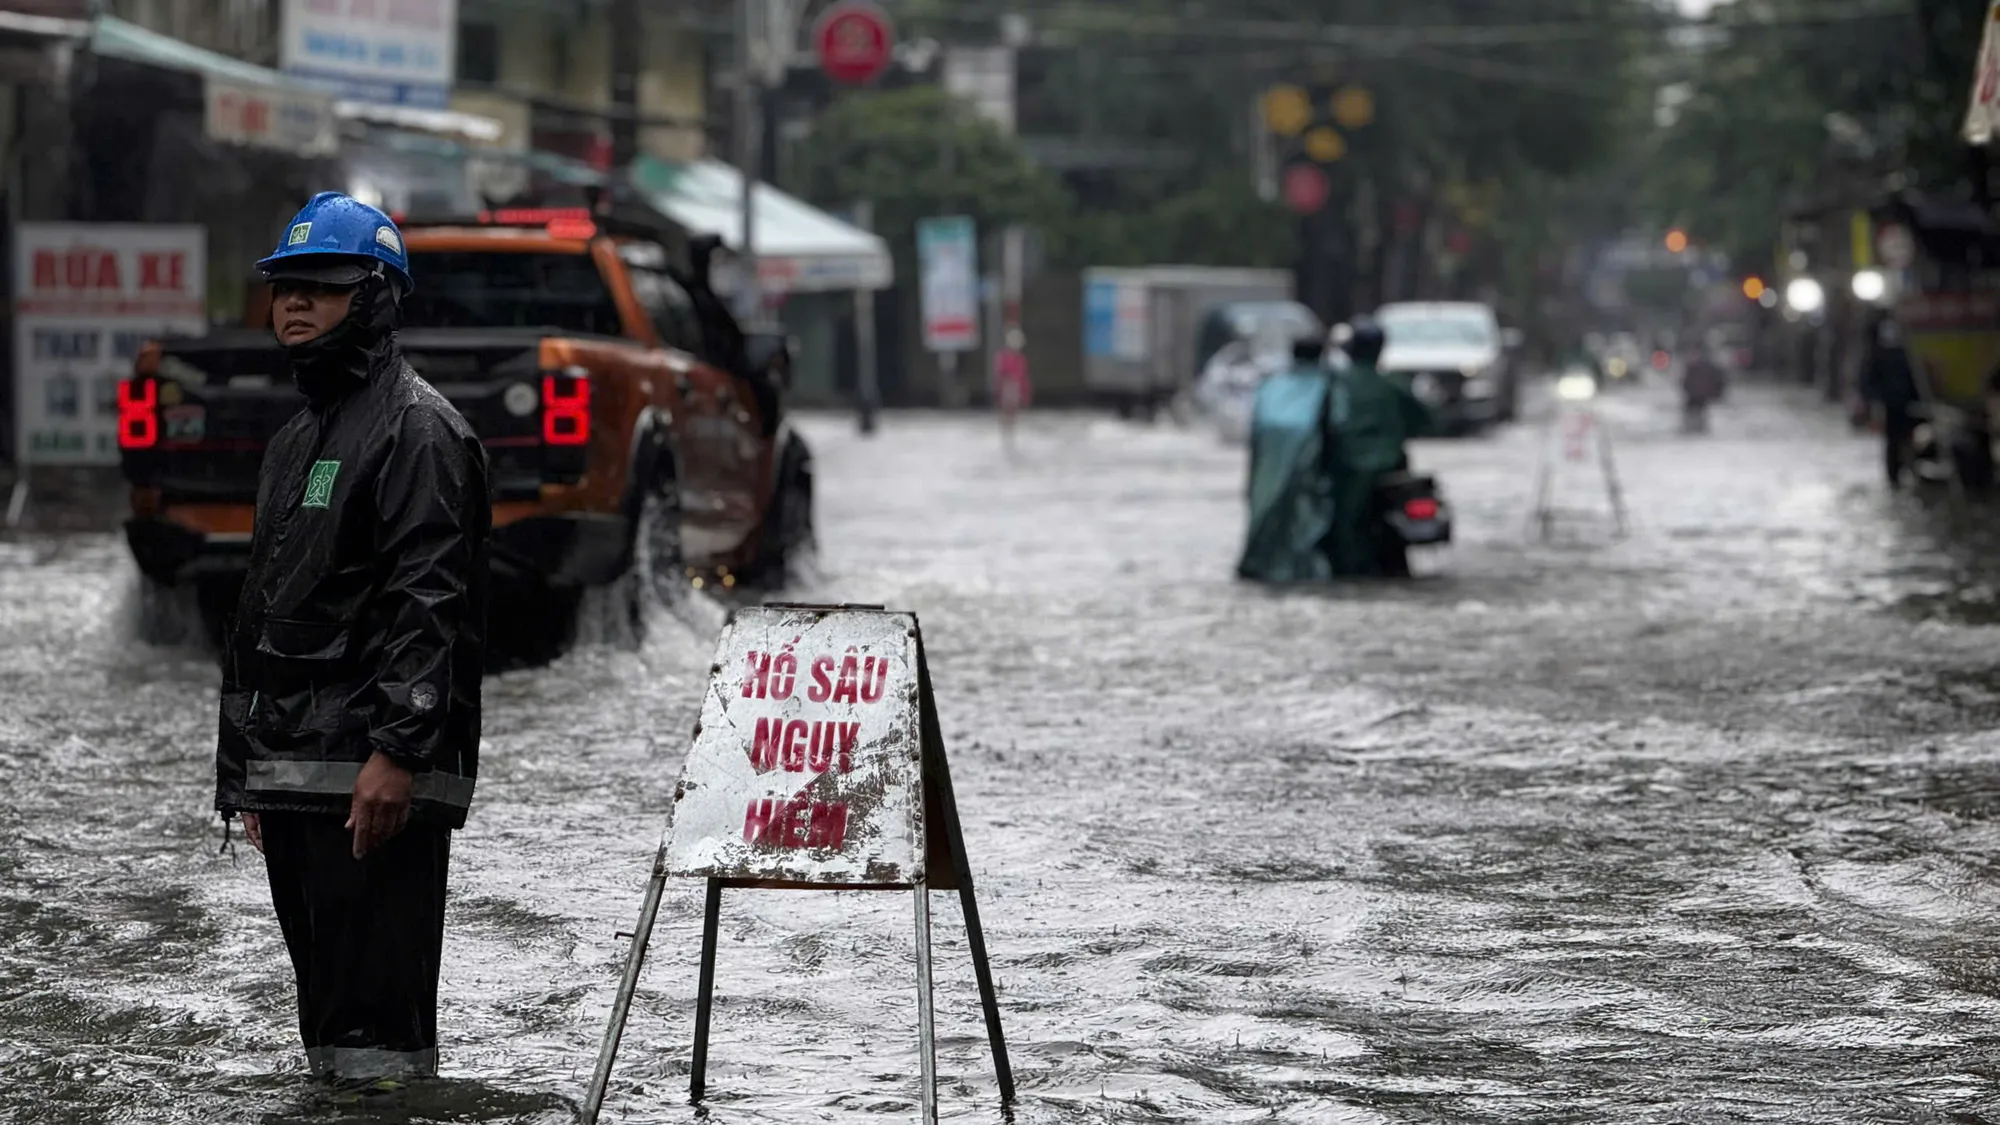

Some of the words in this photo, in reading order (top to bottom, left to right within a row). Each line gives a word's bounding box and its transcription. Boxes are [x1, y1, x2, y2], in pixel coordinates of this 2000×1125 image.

[138, 250, 185, 290] XE
[741, 635, 801, 701] HỐ
[807, 644, 889, 704] SÂU
[751, 717, 862, 774] NGUY
